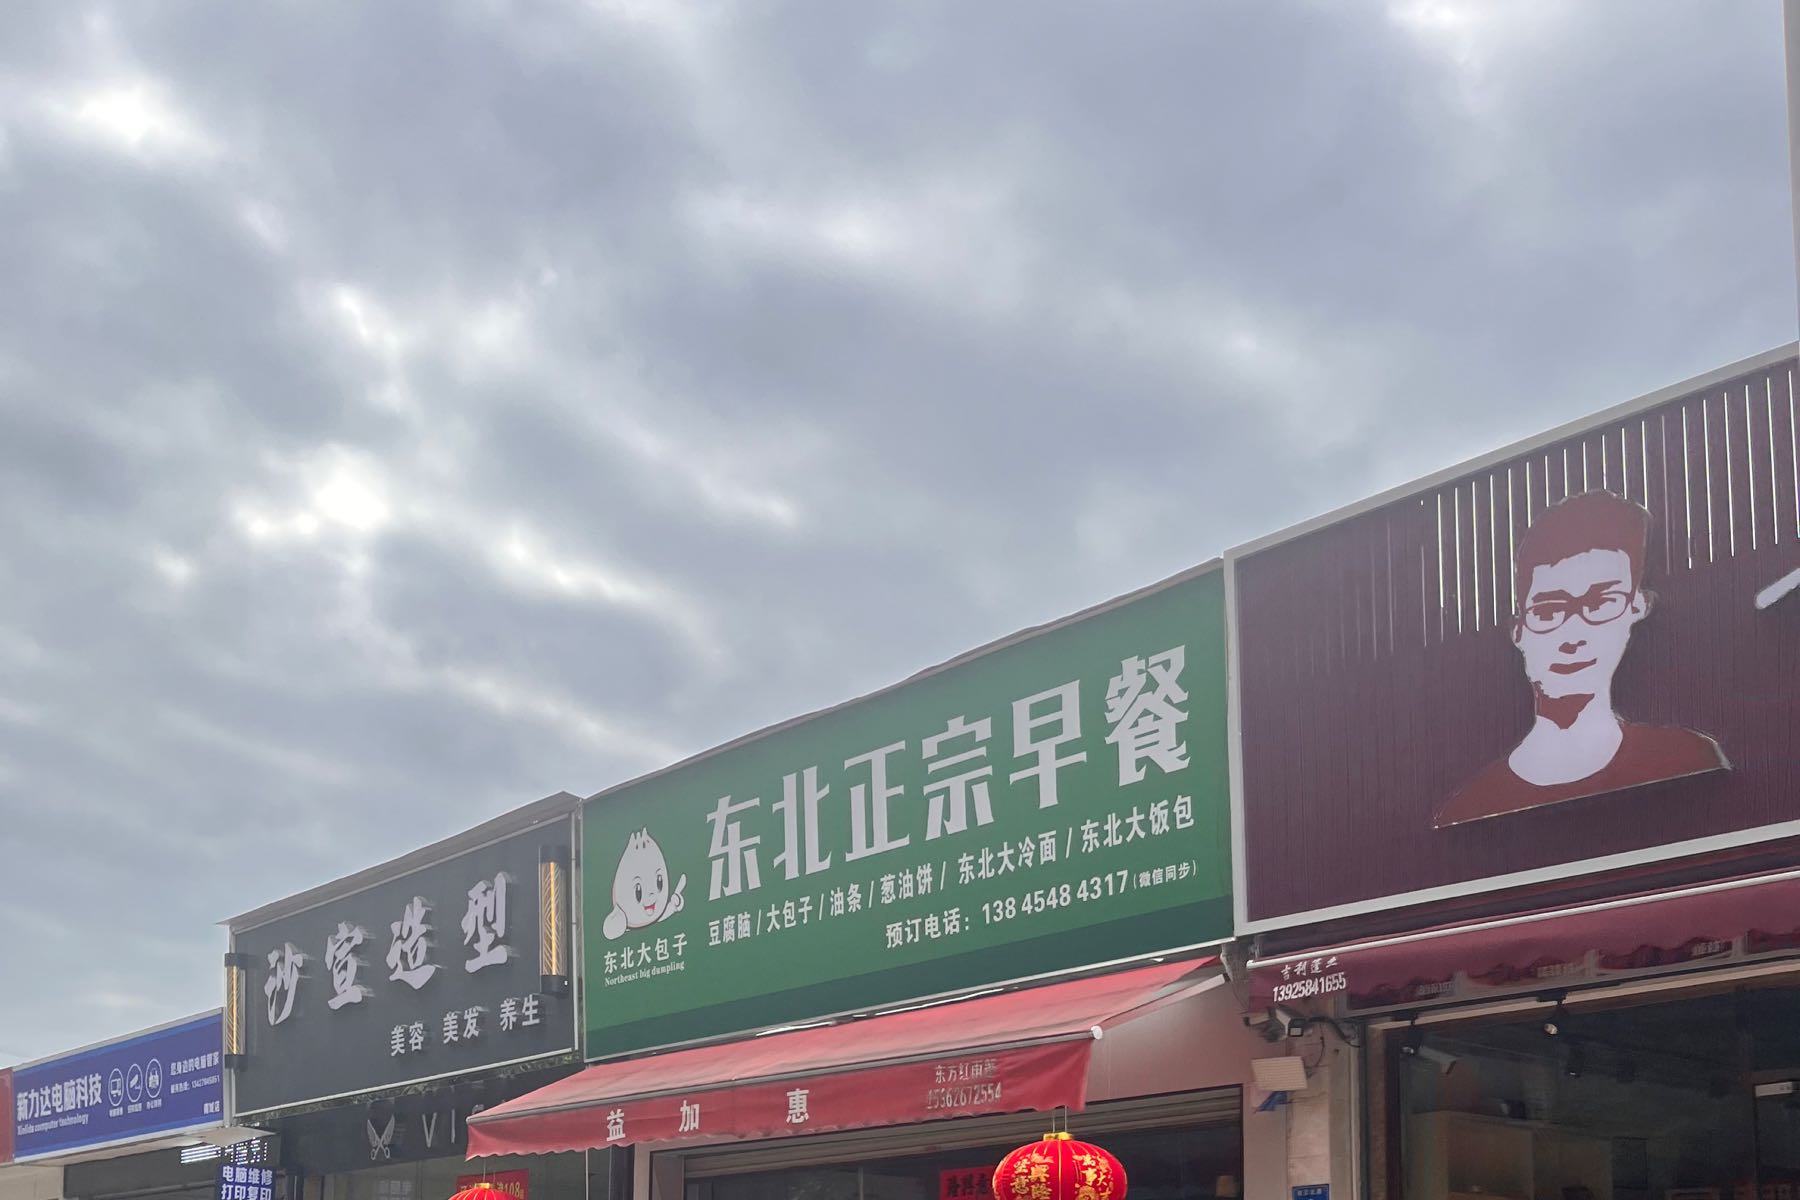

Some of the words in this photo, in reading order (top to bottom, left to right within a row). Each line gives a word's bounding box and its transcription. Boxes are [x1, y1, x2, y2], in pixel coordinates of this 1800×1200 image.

[706, 645, 1191, 900] 东北正宗早餐
[708, 912, 751, 947] 豆腐脑
[766, 896, 813, 933] 大包子
[829, 883, 862, 917] 油条
[880, 863, 933, 905] 葱油饼
[958, 830, 1056, 885] 东北大冷面
[1081, 795, 1194, 853] 东北大饭包
[981, 898, 1016, 924] 138
[1021, 884, 1071, 915] 4548
[1076, 870, 1128, 902] 4317
[264, 872, 507, 1025] 沙宣造型
[604, 933, 688, 975] 东北大包子
[604, 971, 638, 986] Northeast
[639, 968, 650, 979] big
[651, 961, 685, 976] dumpling
[1273, 972, 1346, 1002] 13925841655
[391, 1022, 424, 1056] 美容
[443, 1008, 480, 1044] 美发
[500, 995, 540, 1030] 养生
[17, 1073, 102, 1121] 新力达电脑科技
[35, 1119, 58, 1133] computer
[59, 1113, 89, 1127] technology
[222, 1165, 272, 1186] 电脑维修
